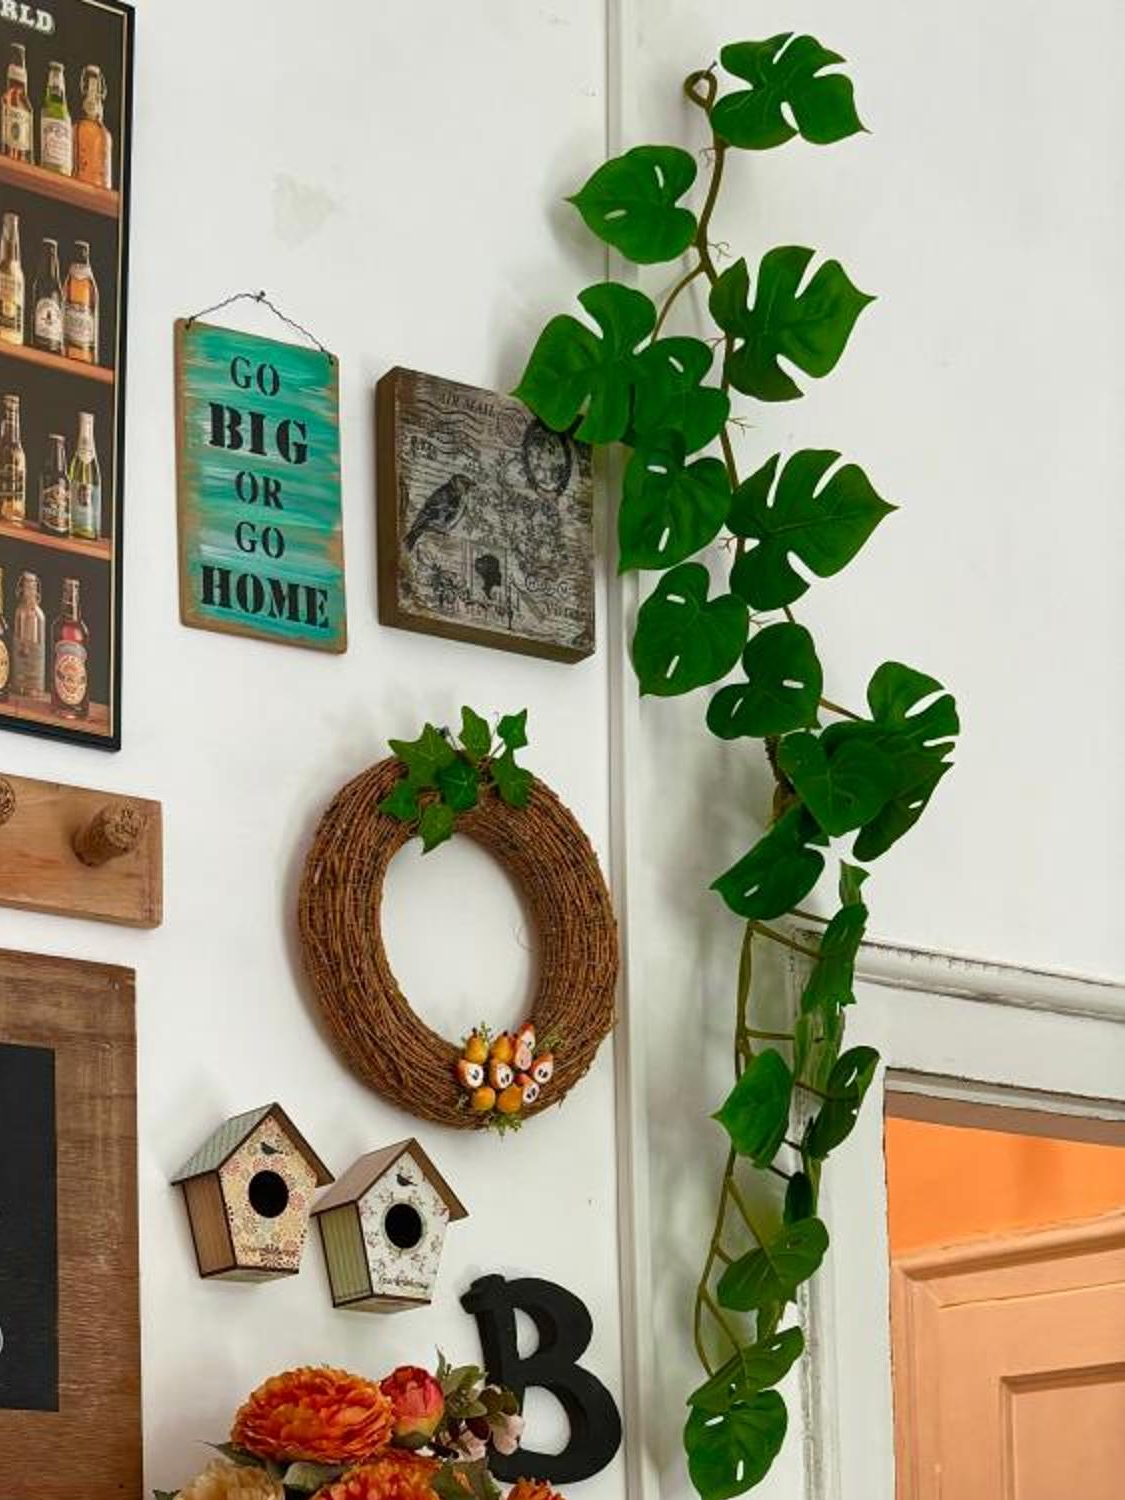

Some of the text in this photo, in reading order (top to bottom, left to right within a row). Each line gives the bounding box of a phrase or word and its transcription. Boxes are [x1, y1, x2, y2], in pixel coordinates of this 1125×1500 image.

[230, 355, 280, 397] GO
[208, 401, 308, 465] BIG
[234, 470, 284, 510] OR
[235, 520, 285, 559] GO
[200, 563, 329, 629] HOME
[459, 1273, 623, 1486] B
